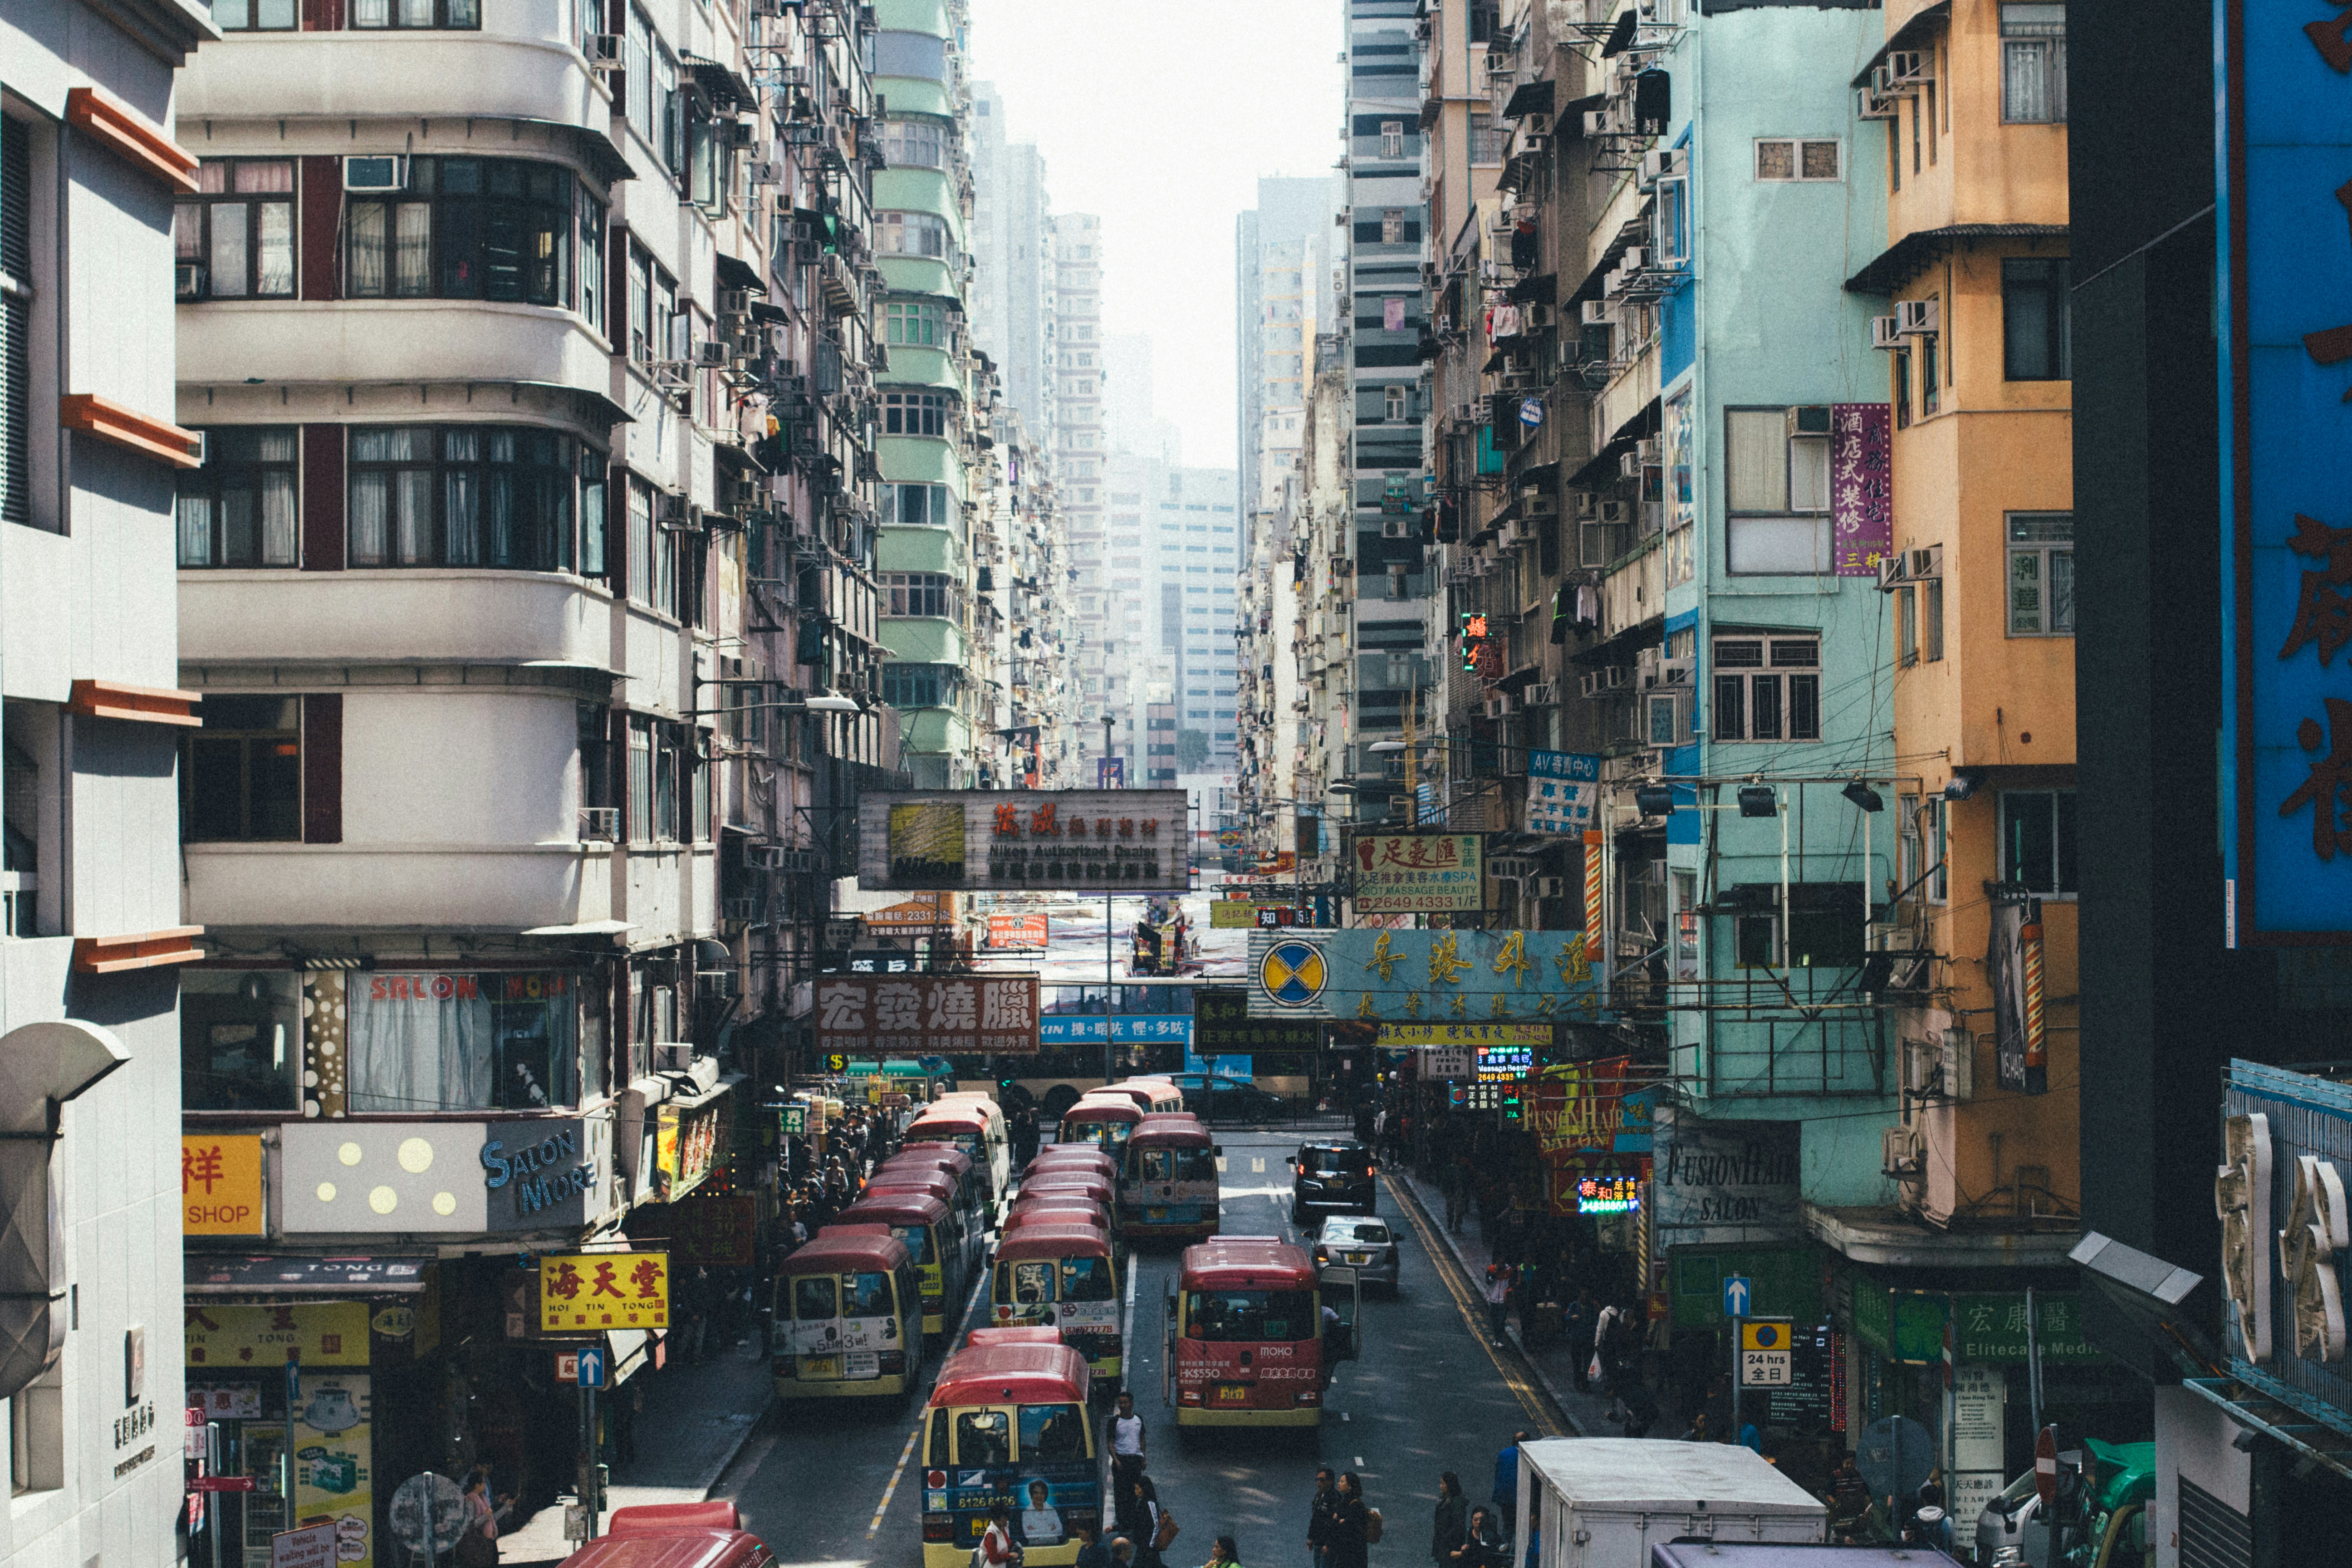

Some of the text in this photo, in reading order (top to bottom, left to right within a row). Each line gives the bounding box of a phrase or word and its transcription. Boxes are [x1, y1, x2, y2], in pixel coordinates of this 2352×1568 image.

[1840, 412, 1864, 534] 酒店式裝修
[1386, 887, 1434, 895] MASSAGE
[1437, 886, 1476, 895] BEAUTY
[1374, 896, 1478, 908] 2649 4333 1/F
[907, 911, 931, 921] 2331
[370, 974, 478, 1000] SALON
[483, 1128, 576, 1189] SALON
[521, 1161, 597, 1218] MORE
[1582, 1180, 1612, 1201] 泰和
[189, 1205, 250, 1224] SHOP
[546, 1259, 664, 1300] 海天堂
[549, 1304, 569, 1312] HOI
[622, 1302, 654, 1310] TONG
[258, 1333, 295, 1343] TONG
[1967, 1343, 2046, 1356] Elitecae
[1748, 1354, 1785, 1365] 24 hrs
[1180, 1368, 1220, 1379] HK$550
[1751, 1367, 1781, 1382] 全日
[1955, 1479, 1994, 1490] 天天應診
[959, 1497, 986, 1508] 8126
[291, 1533, 317, 1547] Vehicle
[279, 1544, 330, 1563] waiting will be
